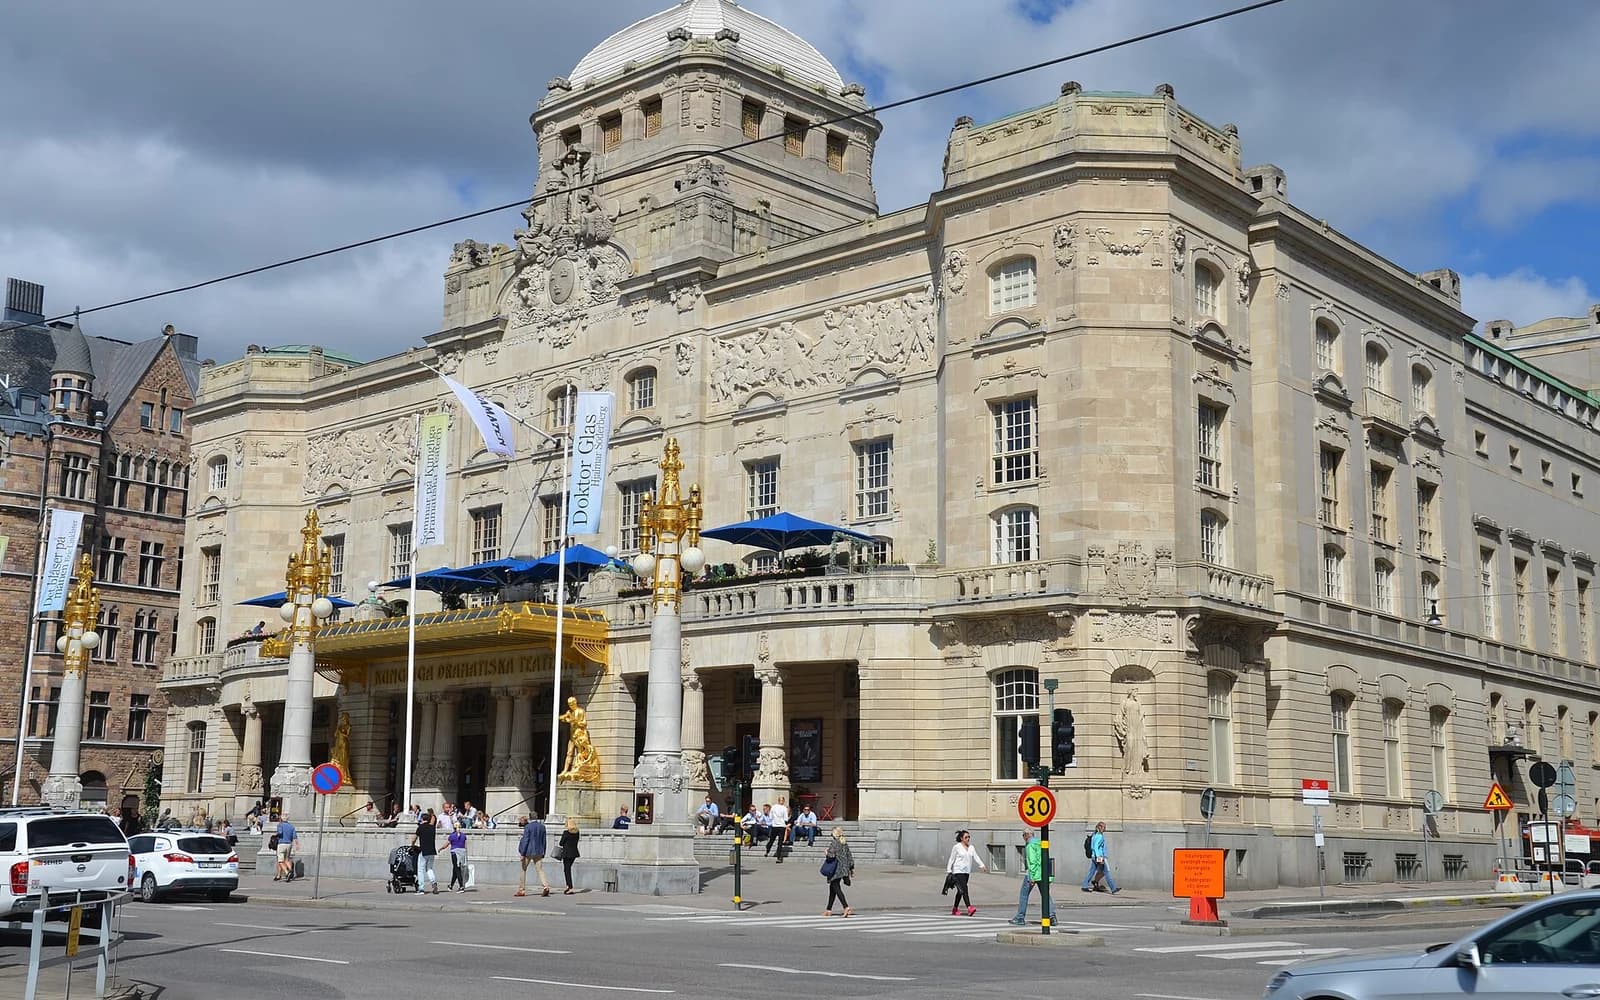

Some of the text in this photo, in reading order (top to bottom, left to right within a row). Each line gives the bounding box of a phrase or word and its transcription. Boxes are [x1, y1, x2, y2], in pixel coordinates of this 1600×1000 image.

[474, 393, 507, 447] AMATEN
[590, 405, 608, 487] Hjalmar Söderberg
[420, 426, 436, 545] Sommar på Kungliga
[425, 427, 442, 540] Dramatiska Teatern
[572, 413, 597, 526] Doktor Glas
[43, 536, 66, 607] Det blåser på
[375, 665, 434, 685] KUNGGA
[437, 657, 514, 680] DRAMATISKA
[1025, 796, 1050, 817] 30
